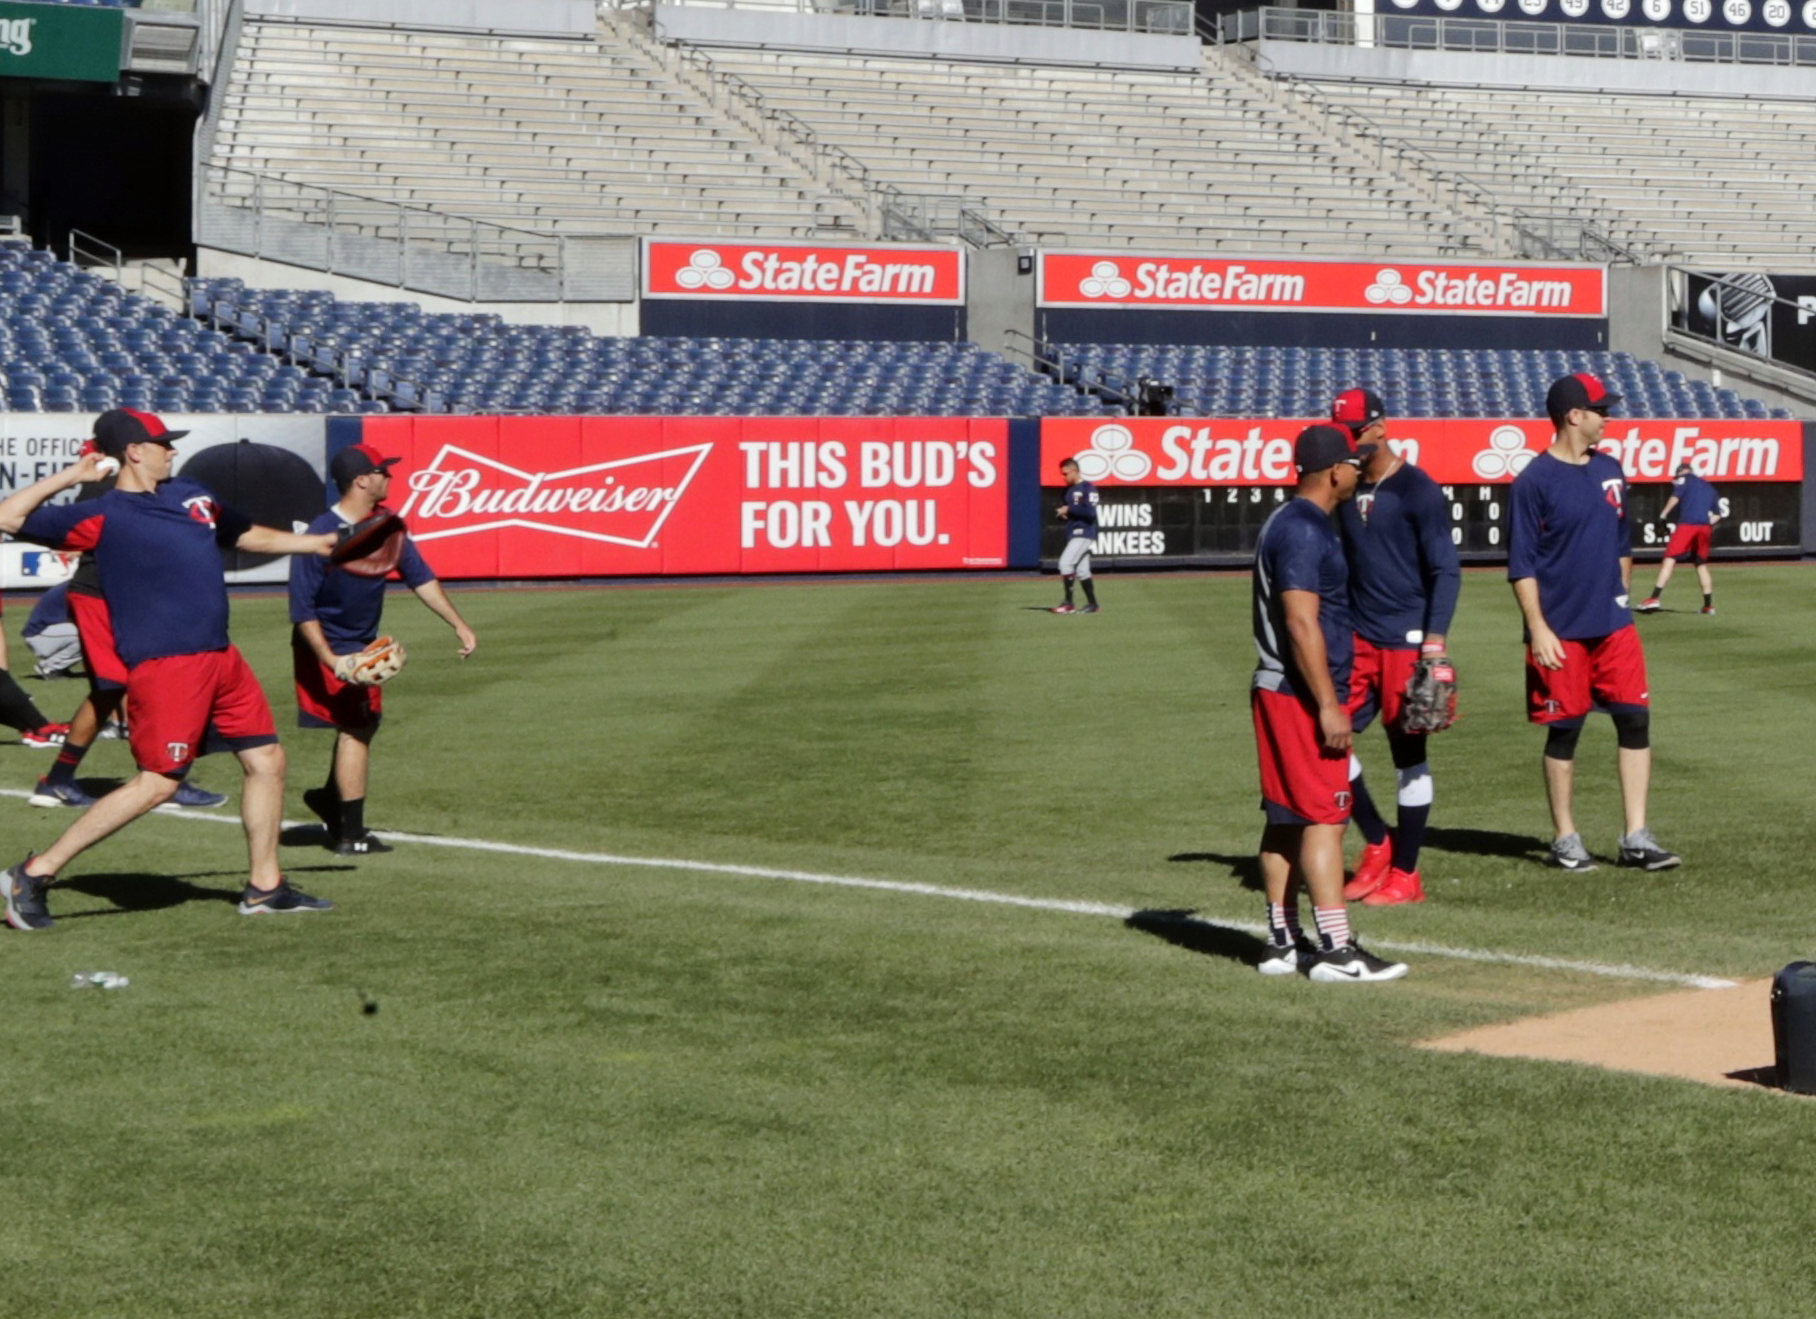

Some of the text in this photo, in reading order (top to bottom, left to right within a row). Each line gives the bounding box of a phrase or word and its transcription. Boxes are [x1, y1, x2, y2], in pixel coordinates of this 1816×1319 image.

[1652, 0, 1661, 13] 6
[1690, 1, 1705, 15] 51
[1729, 3, 1746, 17] 46
[1768, 5, 1785, 19] 20
[739, 439, 996, 488] THIS BUD'S
[400, 468, 680, 520] Budweiser
[1203, 488, 1211, 503] 1
[1227, 488, 1238, 503] 2
[1251, 488, 1262, 503] 3
[1274, 488, 1285, 503] 4
[741, 499, 949, 548] FOR YOU.
[1096, 502, 1500, 528] WINS 0 0
[1488, 526, 1500, 545] 0
[1740, 521, 1774, 542] OUT
